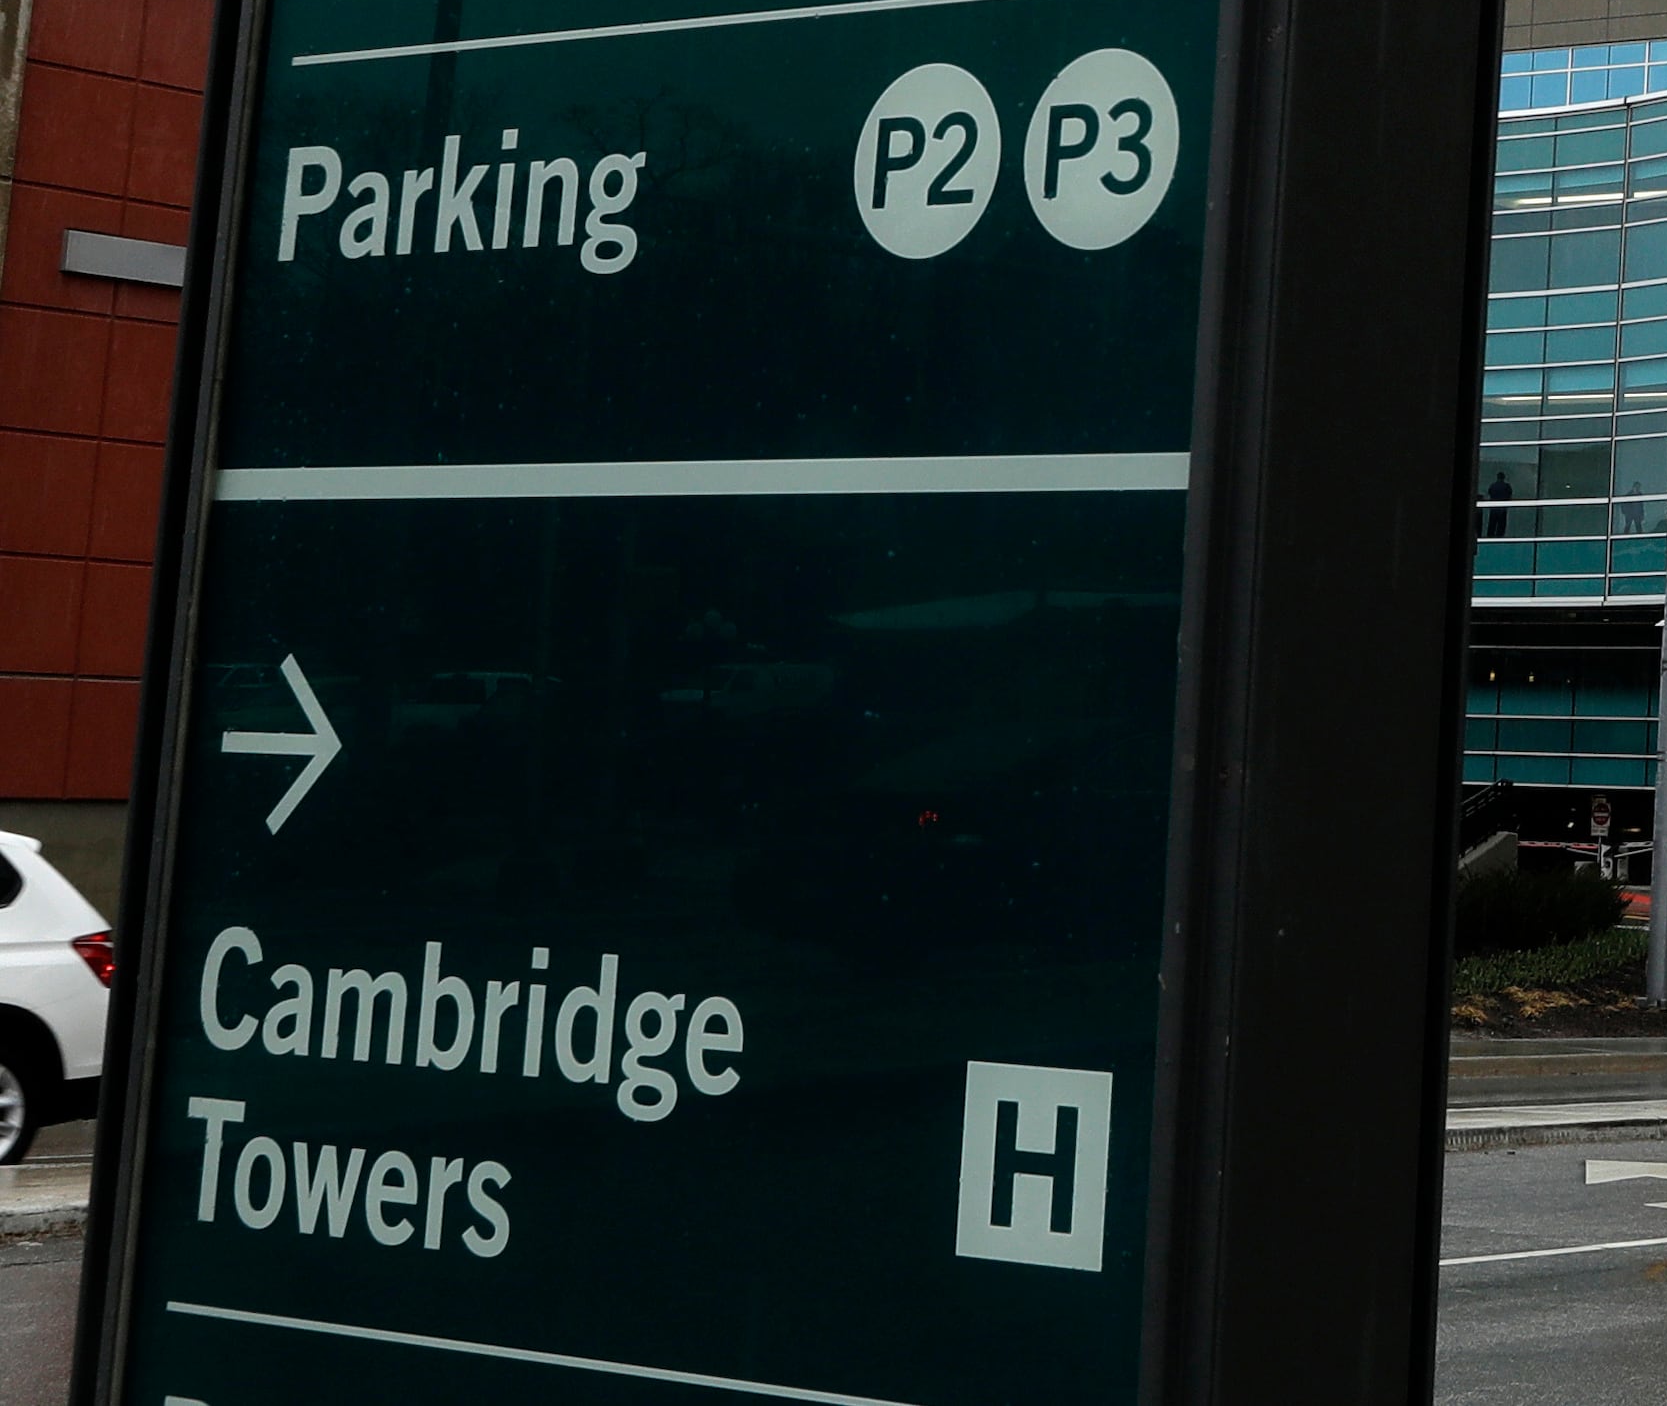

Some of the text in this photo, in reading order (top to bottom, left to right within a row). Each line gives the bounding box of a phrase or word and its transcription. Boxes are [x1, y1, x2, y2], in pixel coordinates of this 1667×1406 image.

[278, 98, 1153, 275] Parking P2 P3
[200, 926, 744, 1122] Cambridge
[188, 1096, 512, 1258] Towers
[989, 1099, 1079, 1235] H
